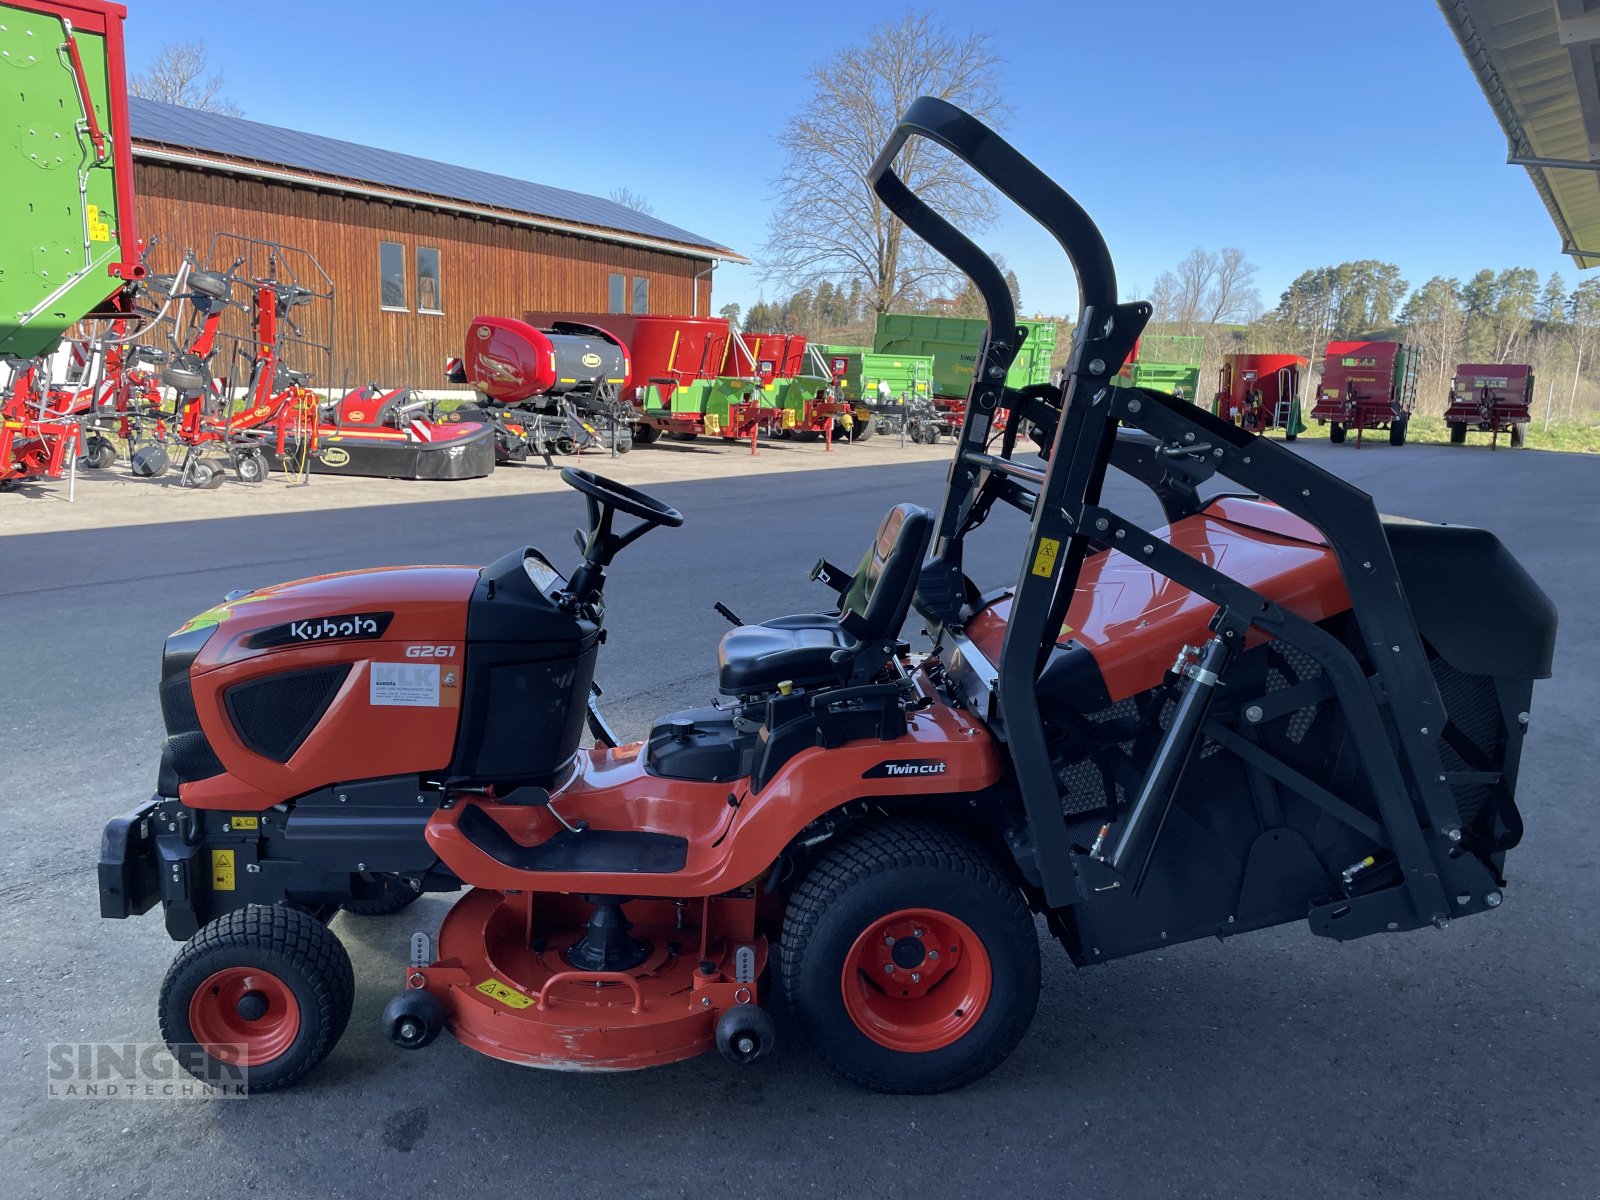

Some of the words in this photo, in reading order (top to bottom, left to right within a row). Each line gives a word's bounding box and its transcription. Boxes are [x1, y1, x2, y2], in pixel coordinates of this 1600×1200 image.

[291, 616, 377, 640] Kubota
[405, 645, 456, 658] G261
[376, 667, 434, 688] KLK
